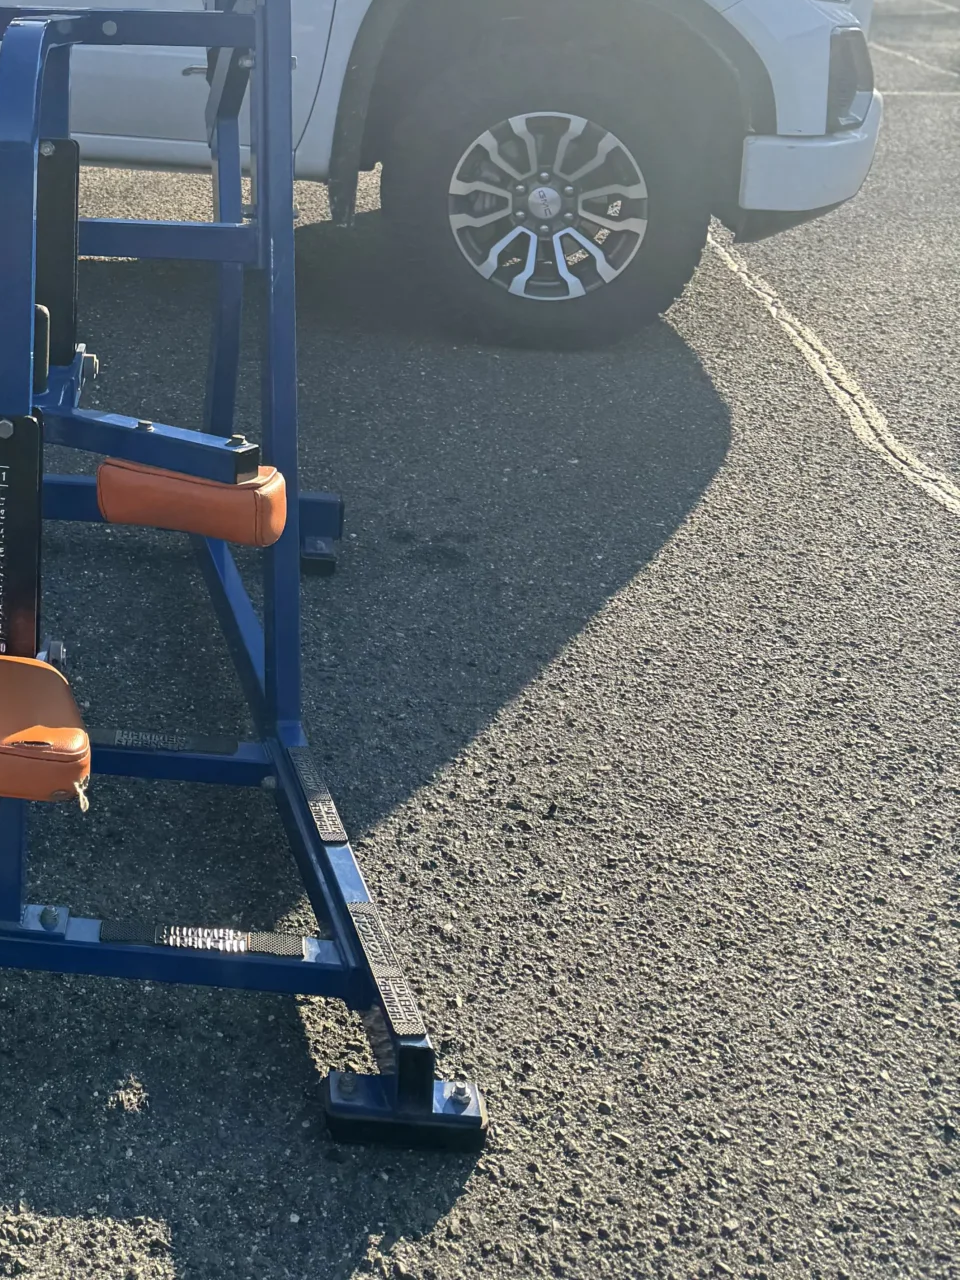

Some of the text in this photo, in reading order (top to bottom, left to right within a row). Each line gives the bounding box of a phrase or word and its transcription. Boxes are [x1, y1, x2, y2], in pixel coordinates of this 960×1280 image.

[539, 190, 552, 216] GMC
[2, 472, 6, 481] 1
[309, 800, 329, 832] HAMMER
[163, 925, 246, 940] HAMMER
[350, 910, 387, 965] MOTION
[378, 977, 404, 1021] HAMMER
[392, 977, 419, 1022] STRENGTH
